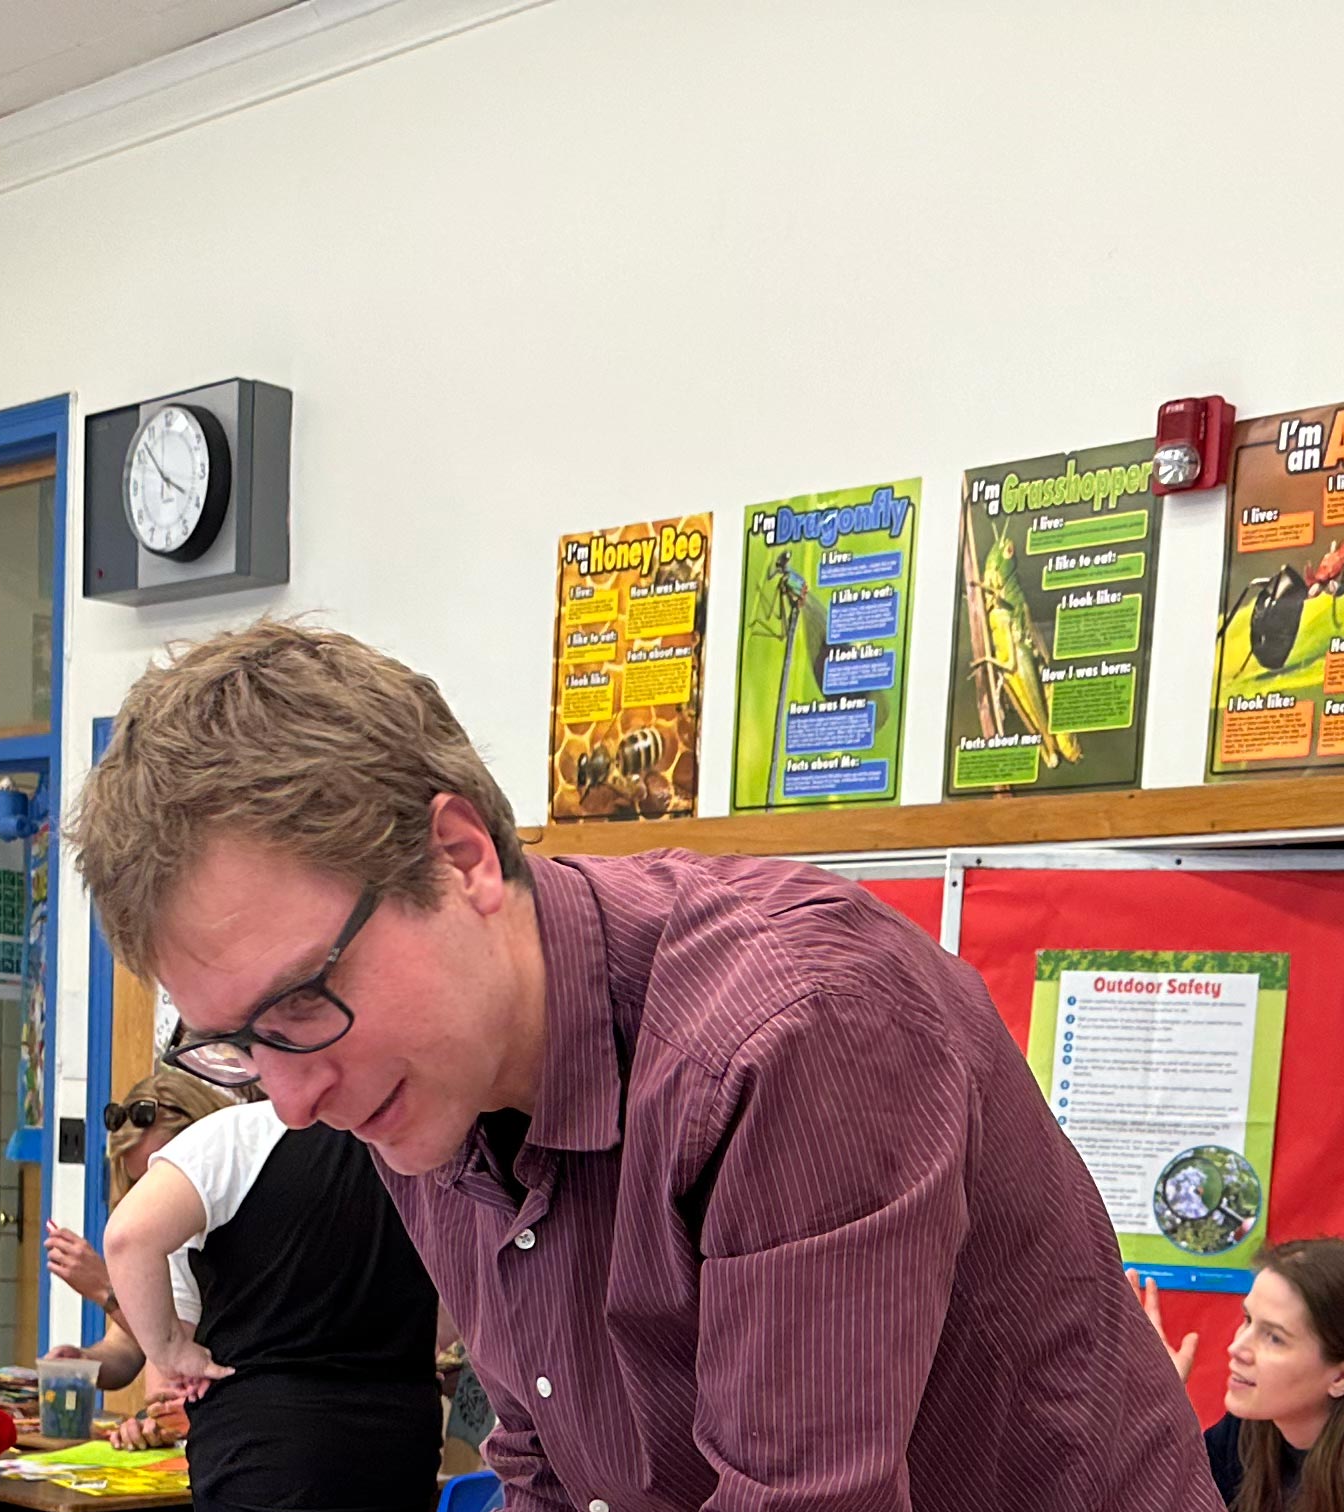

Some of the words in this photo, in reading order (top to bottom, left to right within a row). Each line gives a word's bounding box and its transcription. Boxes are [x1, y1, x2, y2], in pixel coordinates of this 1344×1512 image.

[1278, 420, 1323, 451] I'm
[1287, 447, 1320, 472] an
[972, 481, 1000, 502] I'm
[988, 500, 999, 515] a
[1001, 460, 1154, 514] Grasshopper
[753, 514, 776, 534] I'm
[765, 532, 775, 545] a
[776, 489, 907, 546] Dragonfly
[1250, 506, 1279, 523] live:
[567, 543, 589, 562] I'm
[580, 561, 589, 574] a
[590, 537, 656, 575] Honey
[660, 527, 702, 563] Bee
[1042, 668, 1066, 682] How
[1075, 666, 1098, 679] was
[1101, 662, 1131, 676] born:
[1093, 976, 1163, 995] Outdoor
[1166, 978, 1222, 999] Safety
